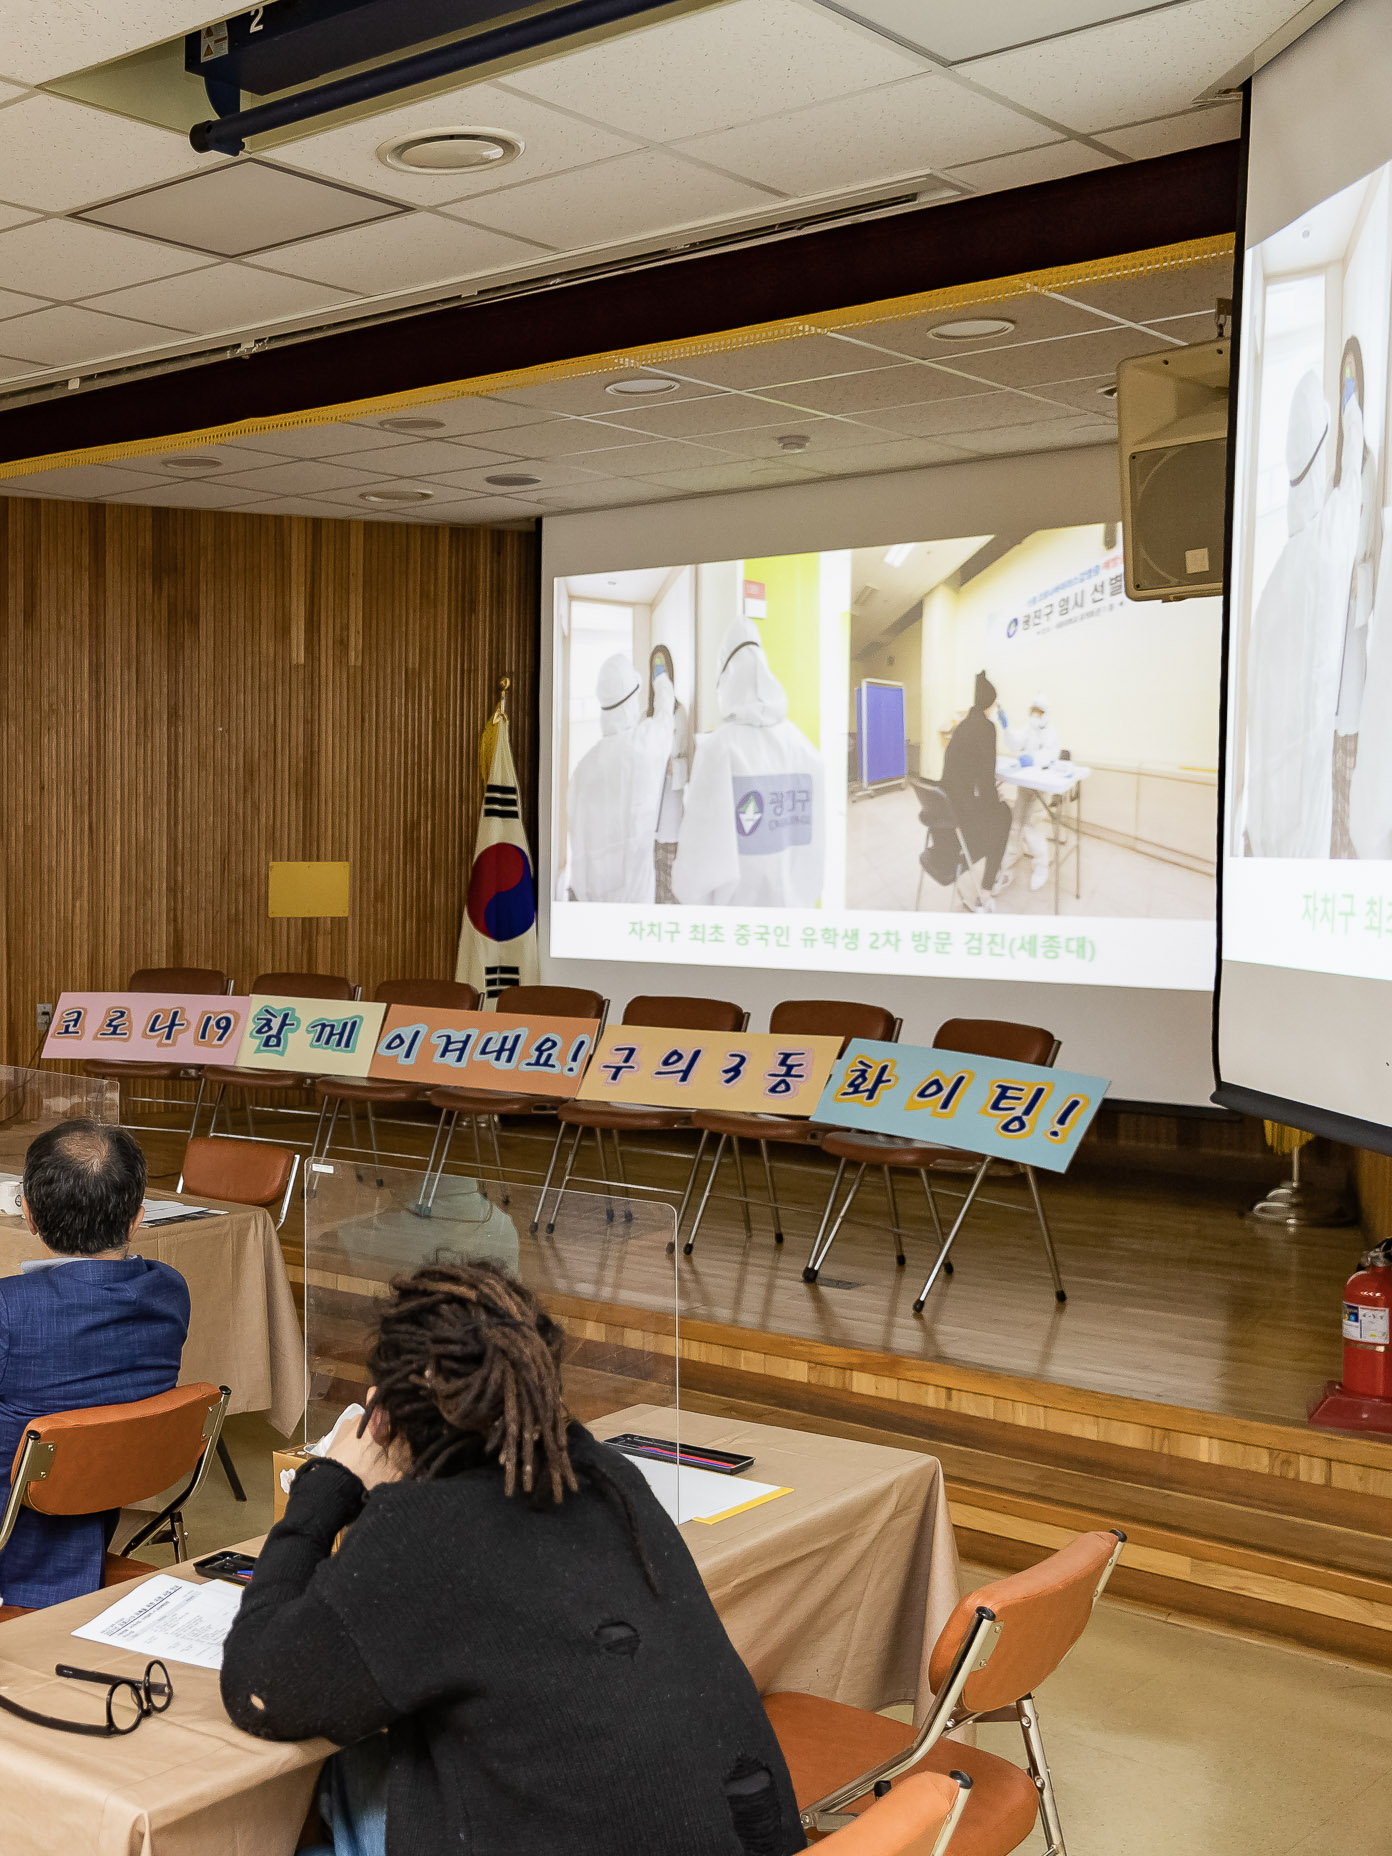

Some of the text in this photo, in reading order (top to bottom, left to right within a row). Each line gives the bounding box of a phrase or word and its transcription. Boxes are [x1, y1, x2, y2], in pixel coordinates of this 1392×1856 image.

[250, 6, 264, 34] 2
[1301, 889, 1357, 936] 자치구
[628, 920, 1096, 962] 자치구 최초 중국인 유학생 2차 방문 검진(세종대)
[55, 1009, 232, 1041] 코로나19
[256, 1009, 358, 1048] 함께
[384, 1029, 585, 1072] 이겨내요!
